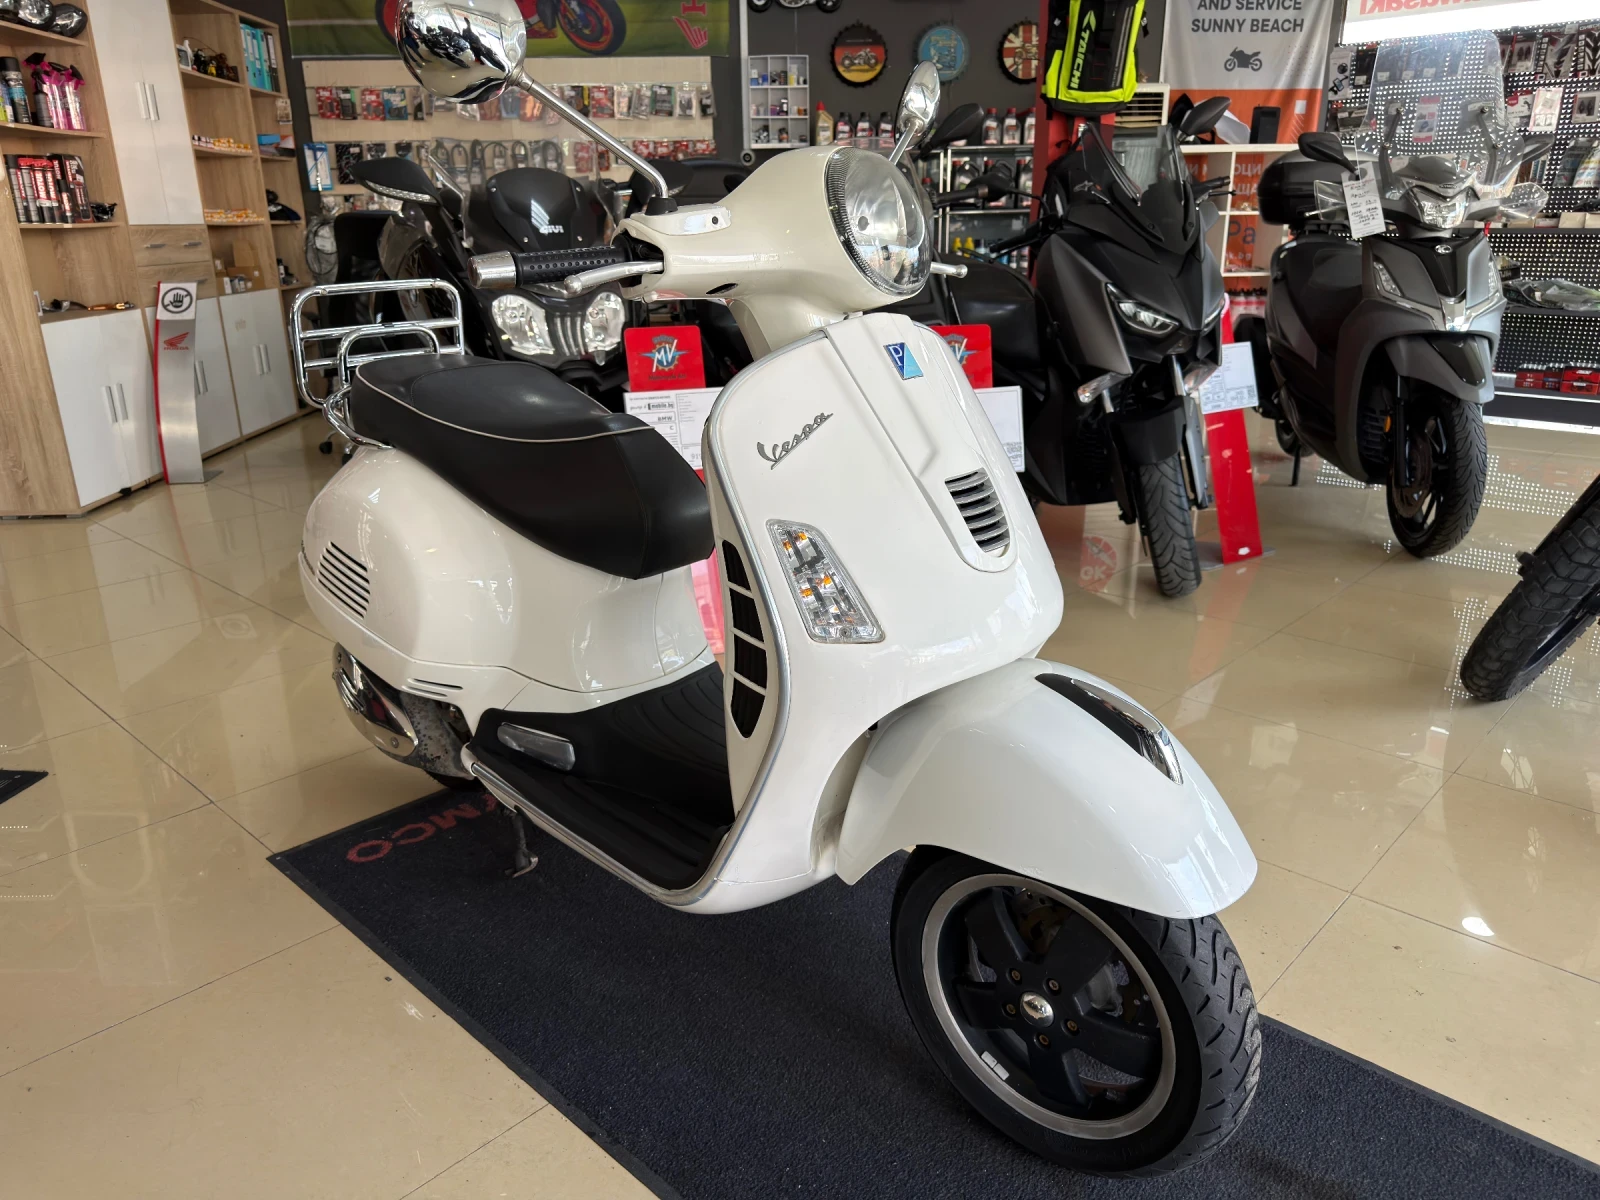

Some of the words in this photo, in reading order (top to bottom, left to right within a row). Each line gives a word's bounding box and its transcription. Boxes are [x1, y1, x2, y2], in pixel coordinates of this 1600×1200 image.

[1191, 18, 1247, 33] SUNNY
[1250, 18, 1304, 33] BEACH
[1070, 29, 1090, 89] TAICHI
[652, 339, 678, 373] MV
[756, 412, 834, 471] Vespa
